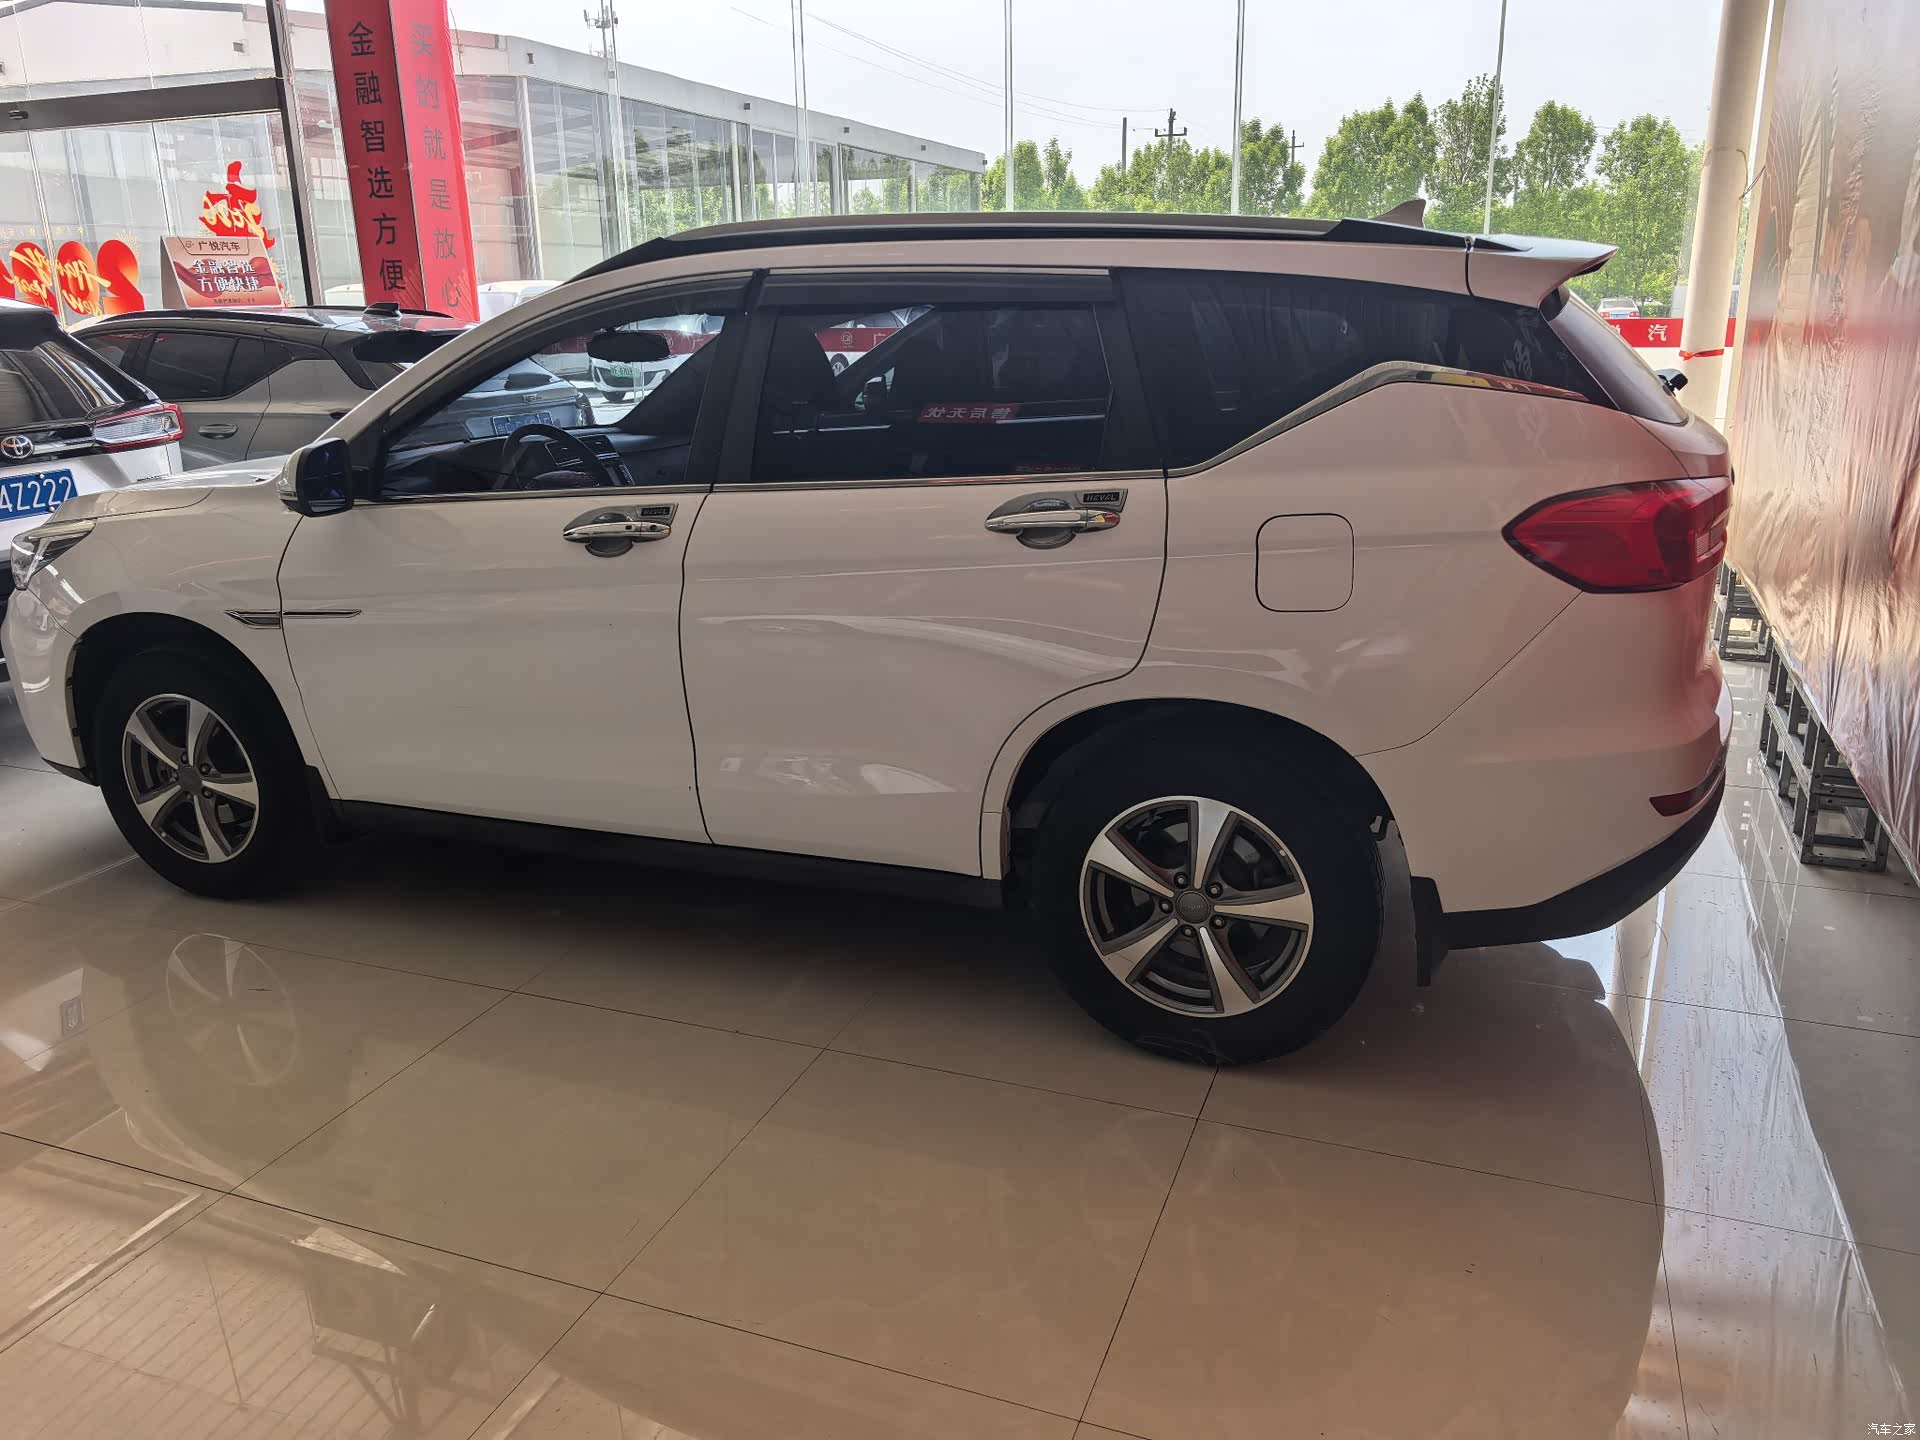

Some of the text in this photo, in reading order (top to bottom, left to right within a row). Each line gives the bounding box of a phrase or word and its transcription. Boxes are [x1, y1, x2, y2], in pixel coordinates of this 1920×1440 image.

[348, 20, 406, 291] 金融智选方便
[409, 22, 462, 307] 买的就是放心
[198, 241, 241, 251] 广悦汽车
[194, 259, 255, 274] 金融智选
[198, 277, 261, 292] 方便快捷
[1086, 491, 1118, 502] HAVAL
